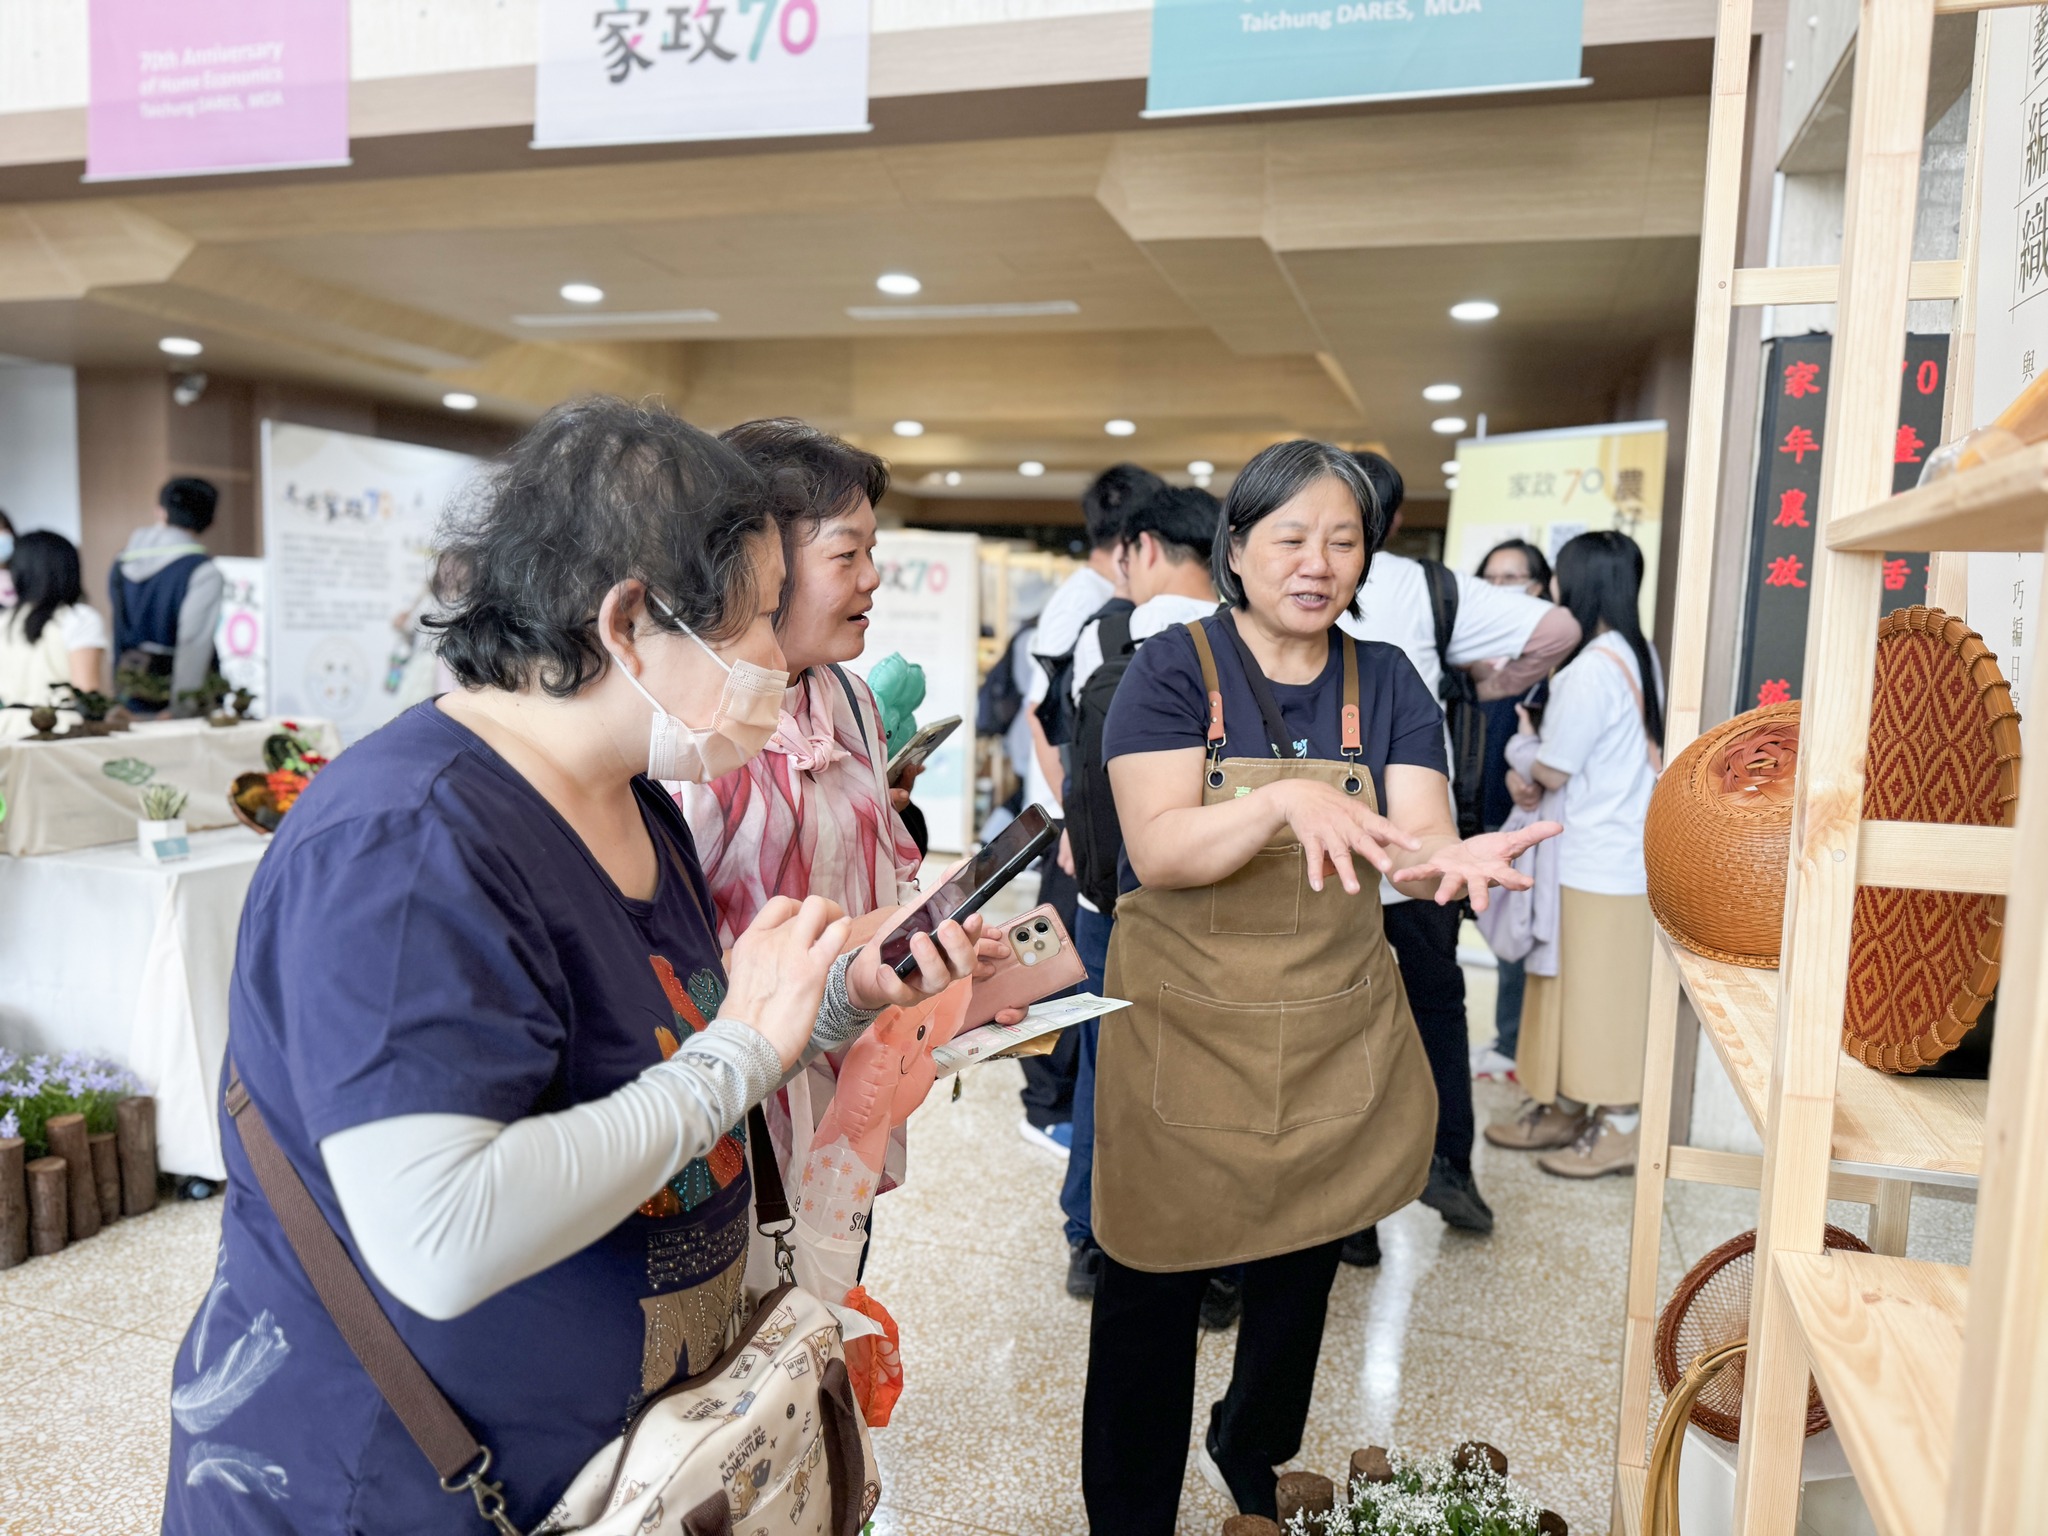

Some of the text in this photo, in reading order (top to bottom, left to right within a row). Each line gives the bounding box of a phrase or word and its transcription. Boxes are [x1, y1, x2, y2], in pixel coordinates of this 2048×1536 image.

[1240, 0, 1482, 33] Taichung DARES, MOA
[139, 41, 285, 72] 70th Anniversary
[594, 0, 818, 84] 家政70
[139, 77, 156, 96] of
[203, 67, 284, 89] Economics
[718, 1425, 762, 1471] WE ARE LIVING OUR
[720, 1431, 768, 1487] ADVENTURE
